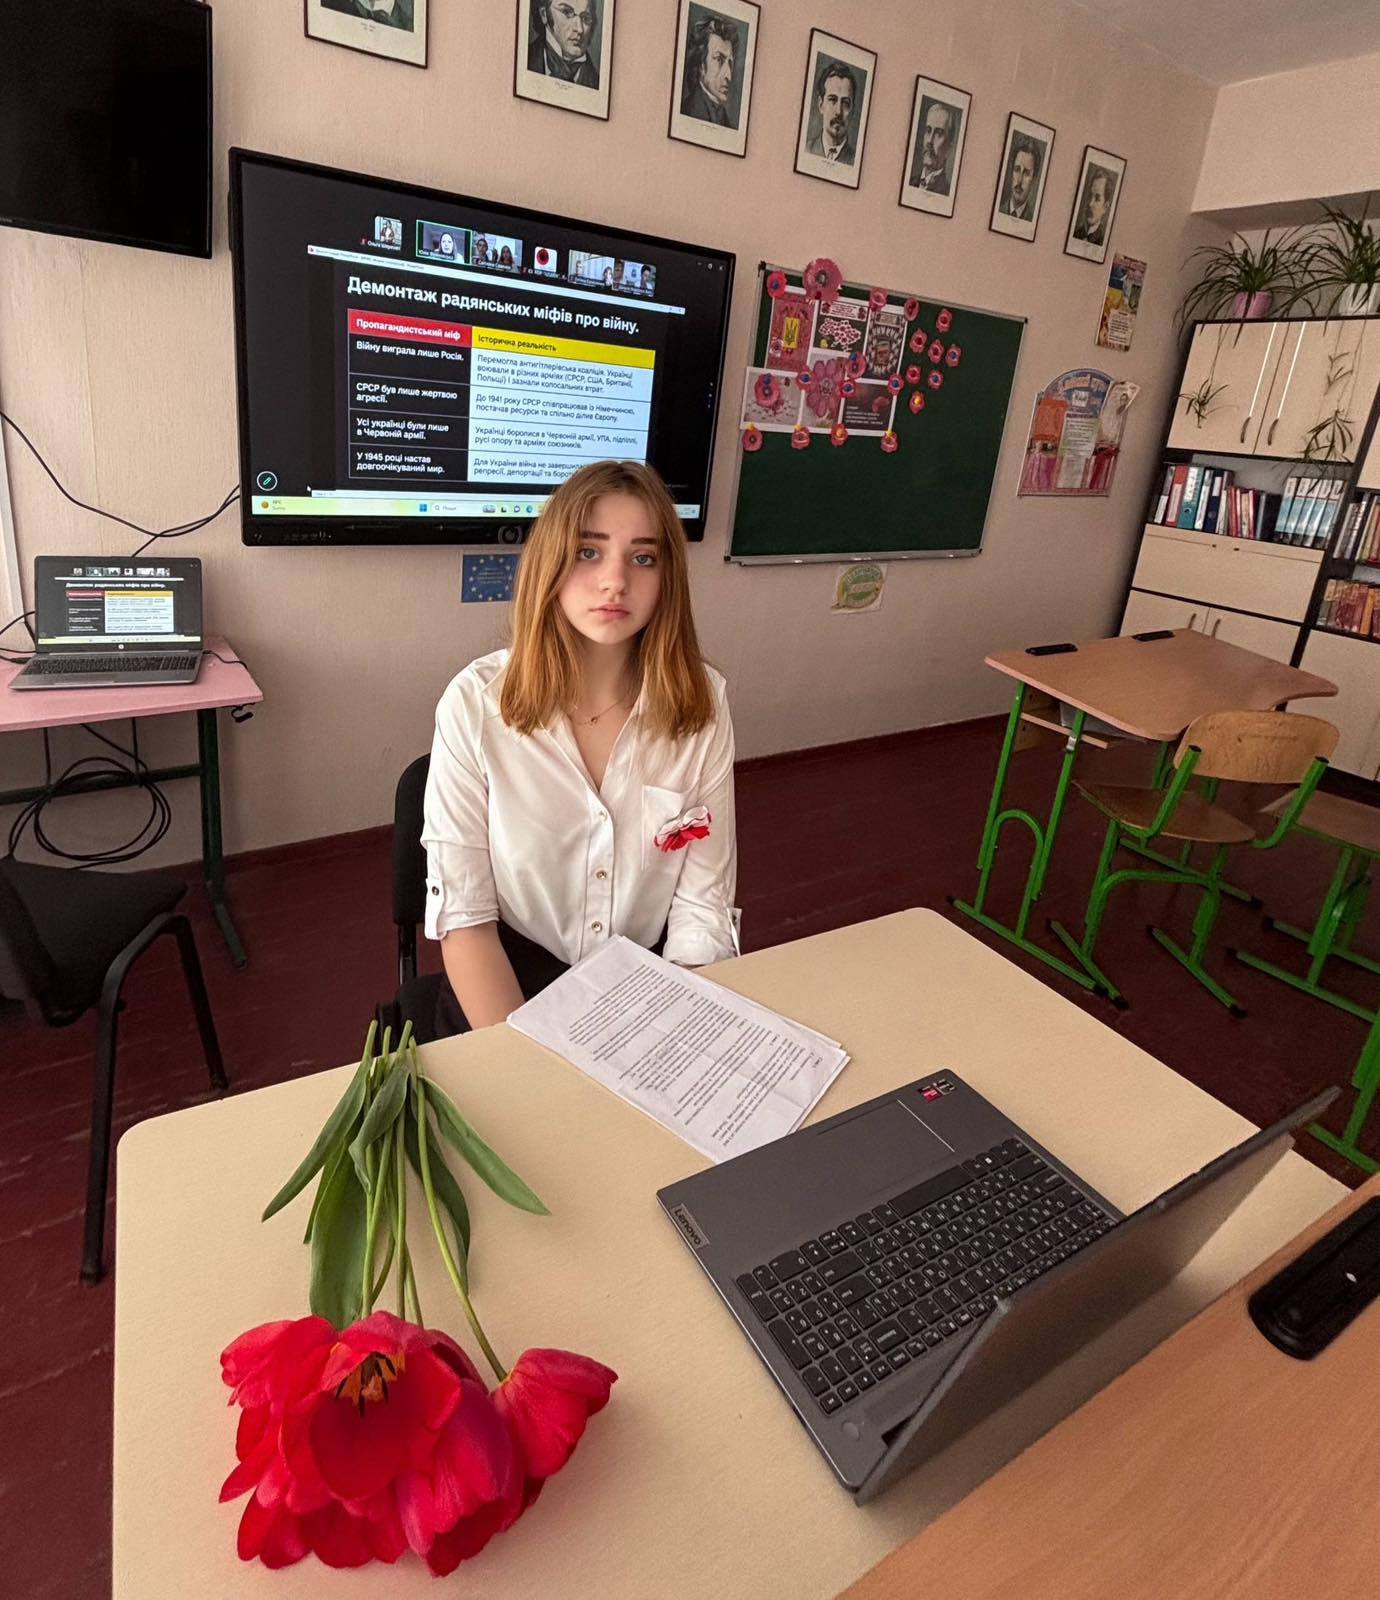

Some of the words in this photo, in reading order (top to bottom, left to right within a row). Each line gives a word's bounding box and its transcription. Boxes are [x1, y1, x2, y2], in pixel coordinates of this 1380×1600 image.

[347, 276, 437, 303] Демонтаж
[441, 293, 530, 318] радянських
[534, 306, 572, 323] міфів
[576, 314, 600, 328] про
[603, 316, 639, 335] війну.
[356, 319, 442, 336] Пропагандистський
[444, 330, 461, 341] міф
[478, 334, 516, 347] Історична
[517, 340, 557, 351] реальність
[356, 341, 380, 353] Війну
[382, 345, 416, 356] виграла
[417, 349, 439, 358] лише
[441, 350, 464, 361] Росія.
[478, 354, 518, 366] Перемогла
[520, 360, 576, 372] антигітлерівська
[607, 370, 633, 379] Українці
[477, 366, 509, 374] воювали
[517, 369, 539, 377] різних
[565, 374, 586, 384] (СРСР,
[588, 377, 605, 385] США,
[606, 378, 633, 388] Британії,
[477, 373, 506, 384] Польщі)
[512, 378, 540, 386] зазнали
[541, 381, 583, 390] колосальних
[356, 383, 380, 392] СРСР
[381, 384, 396, 395] був
[398, 388, 420, 396] лише
[421, 389, 458, 399] жертвою
[356, 394, 388, 403] агресії.
[476, 394, 486, 402] До
[488, 395, 502, 403] 1941
[504, 398, 520, 406] року
[542, 400, 588, 410] співпрацював
[476, 404, 509, 413] постачав
[510, 407, 539, 415] ресурси
[550, 410, 575, 418] спільно
[356, 418, 370, 426] Усі
[371, 419, 405, 430] українці
[407, 421, 426, 431] були
[428, 424, 449, 432] лише
[363, 428, 401, 438] Червоній
[404, 431, 426, 440] армії.
[475, 426, 506, 436] Українці
[507, 429, 540, 437] боролися
[546, 432, 577, 440] Червоній
[475, 437, 489, 445] русі
[356, 452, 363, 460] У
[364, 453, 383, 461] 1945
[384, 453, 403, 463] році
[474, 458, 488, 466] Для
[489, 459, 517, 467] України
[356, 462, 425, 473] довгоочікуваний
[427, 465, 445, 474] мир.
[474, 468, 506, 476] репресії,
[507, 469, 543, 477] депортації
[674, 1209, 701, 1244] Lenovo
